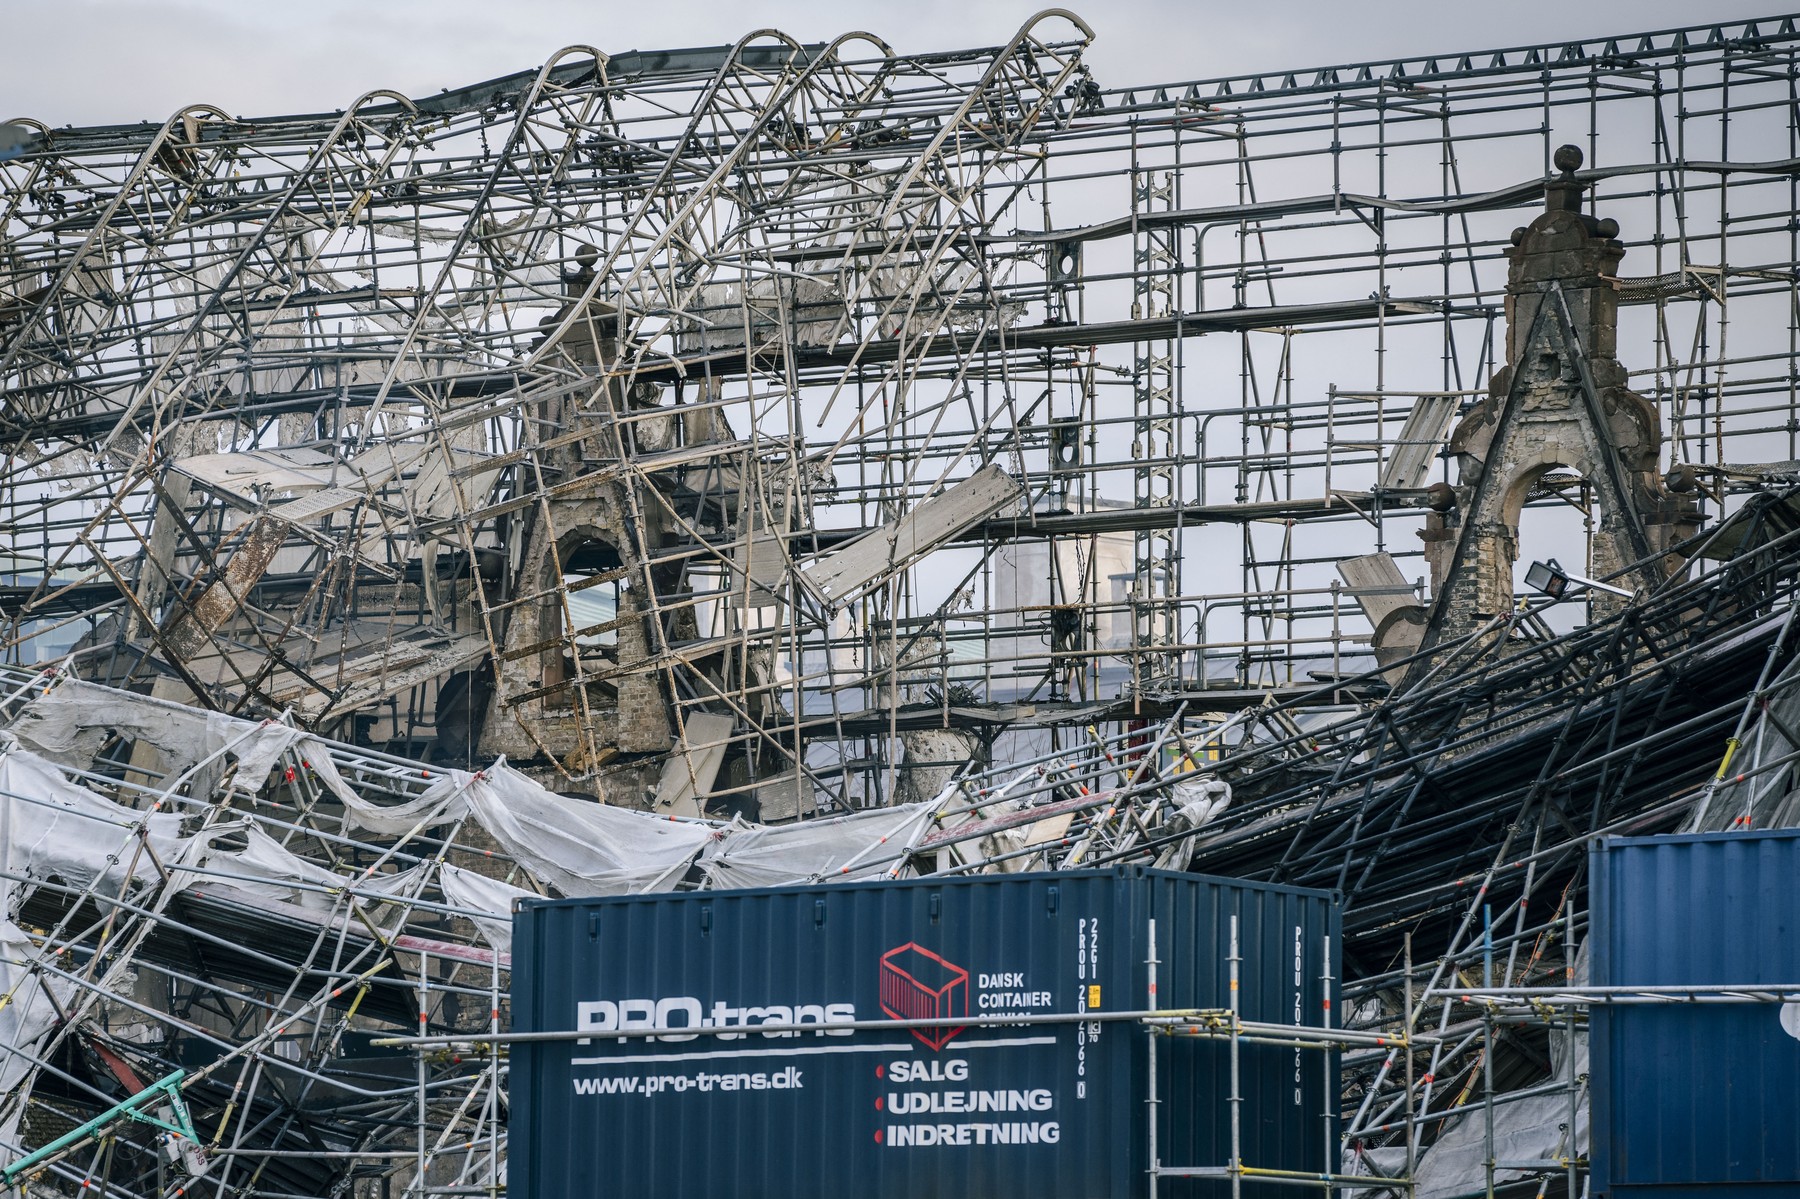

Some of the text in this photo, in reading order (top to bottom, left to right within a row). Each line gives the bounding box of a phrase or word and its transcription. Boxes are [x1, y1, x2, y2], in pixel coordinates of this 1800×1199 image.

[1090, 918, 1098, 979] 22G1
[978, 973, 1024, 989] DANSK
[978, 991, 1052, 1008] CONTAINER
[573, 1066, 803, 1097] www.pro-trans.dk
[889, 1060, 969, 1082] SALG
[888, 1089, 1053, 1114] UDLEJNING
[887, 1122, 1060, 1147] INDRETNING
